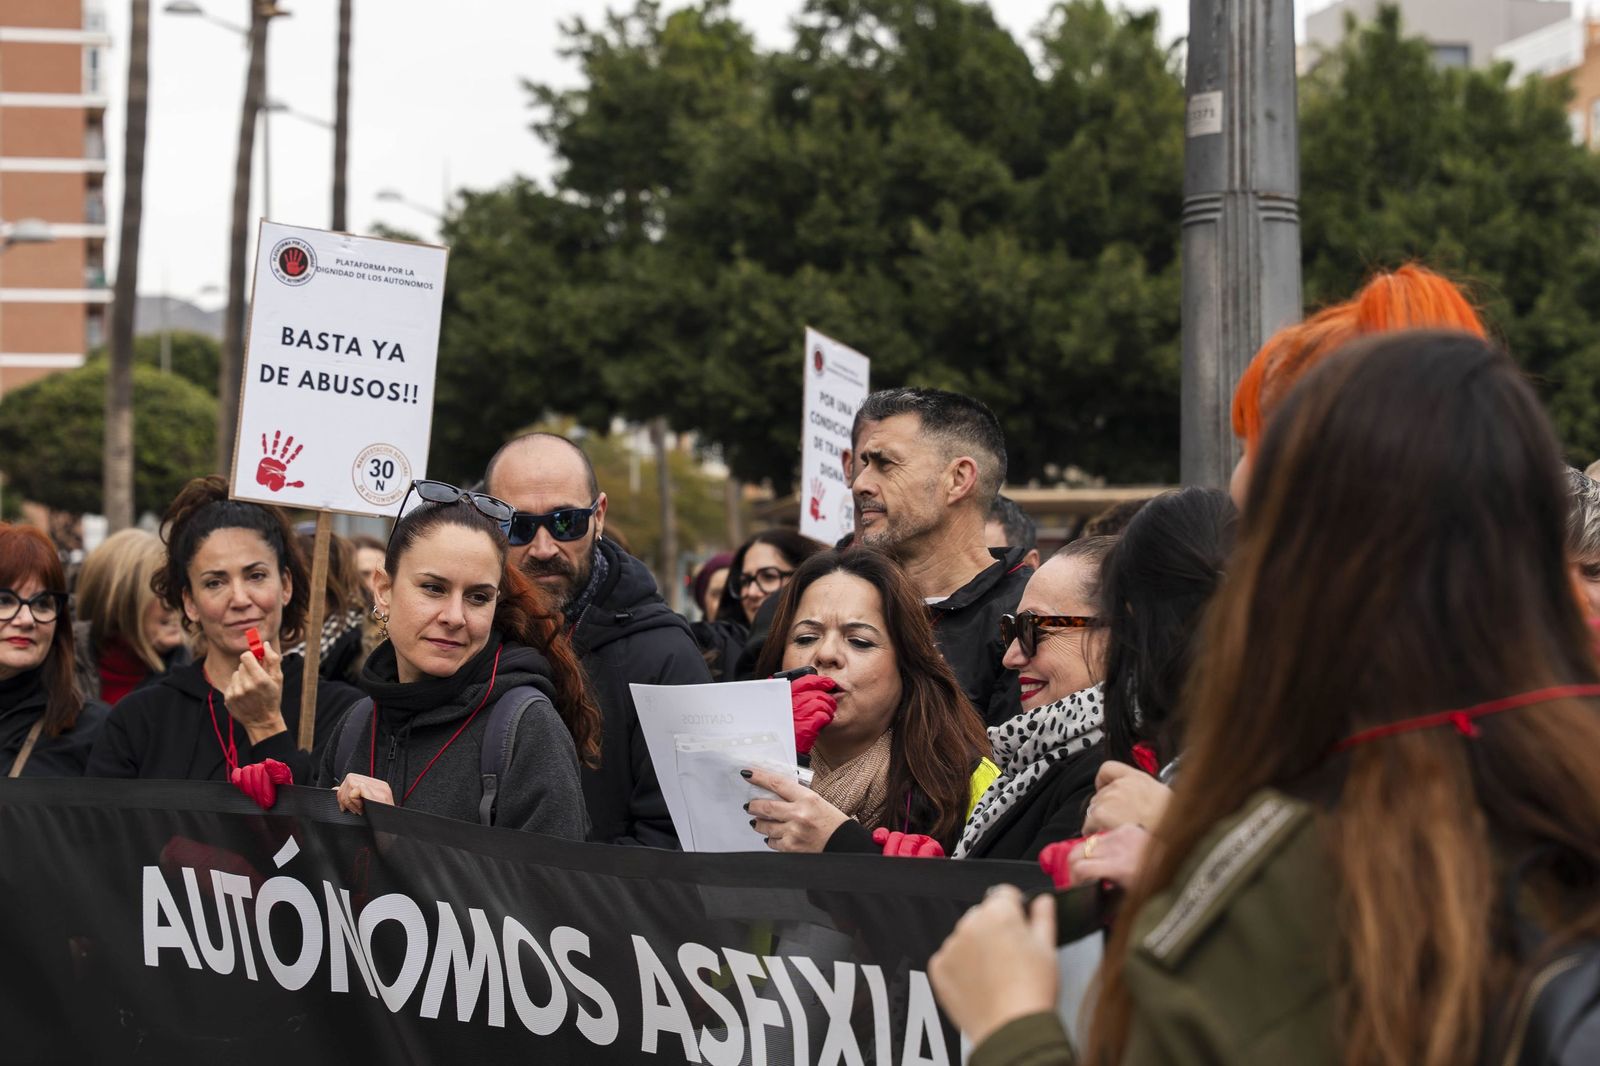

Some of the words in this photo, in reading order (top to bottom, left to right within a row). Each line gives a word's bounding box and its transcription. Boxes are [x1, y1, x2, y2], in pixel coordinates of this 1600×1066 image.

[336, 258, 386, 272] PLATAFORMA
[387, 266, 403, 274] POR
[316, 267, 354, 278] DIGNIDAD
[356, 272, 366, 280] DE
[368, 274, 382, 282] LOS
[384, 277, 434, 290] AUTONOMOS
[281, 326, 362, 356] BASTA
[373, 340, 406, 362] YA
[260, 364, 289, 386] DE
[298, 370, 418, 404] ABUSOS!!
[820, 392, 834, 408] POR
[814, 436, 823, 451] DE
[369, 459, 394, 479] 30
[376, 480, 384, 491] N
[143, 835, 618, 1045] AUTÓNOMOS
[631, 934, 974, 1066] ASFIXIA
